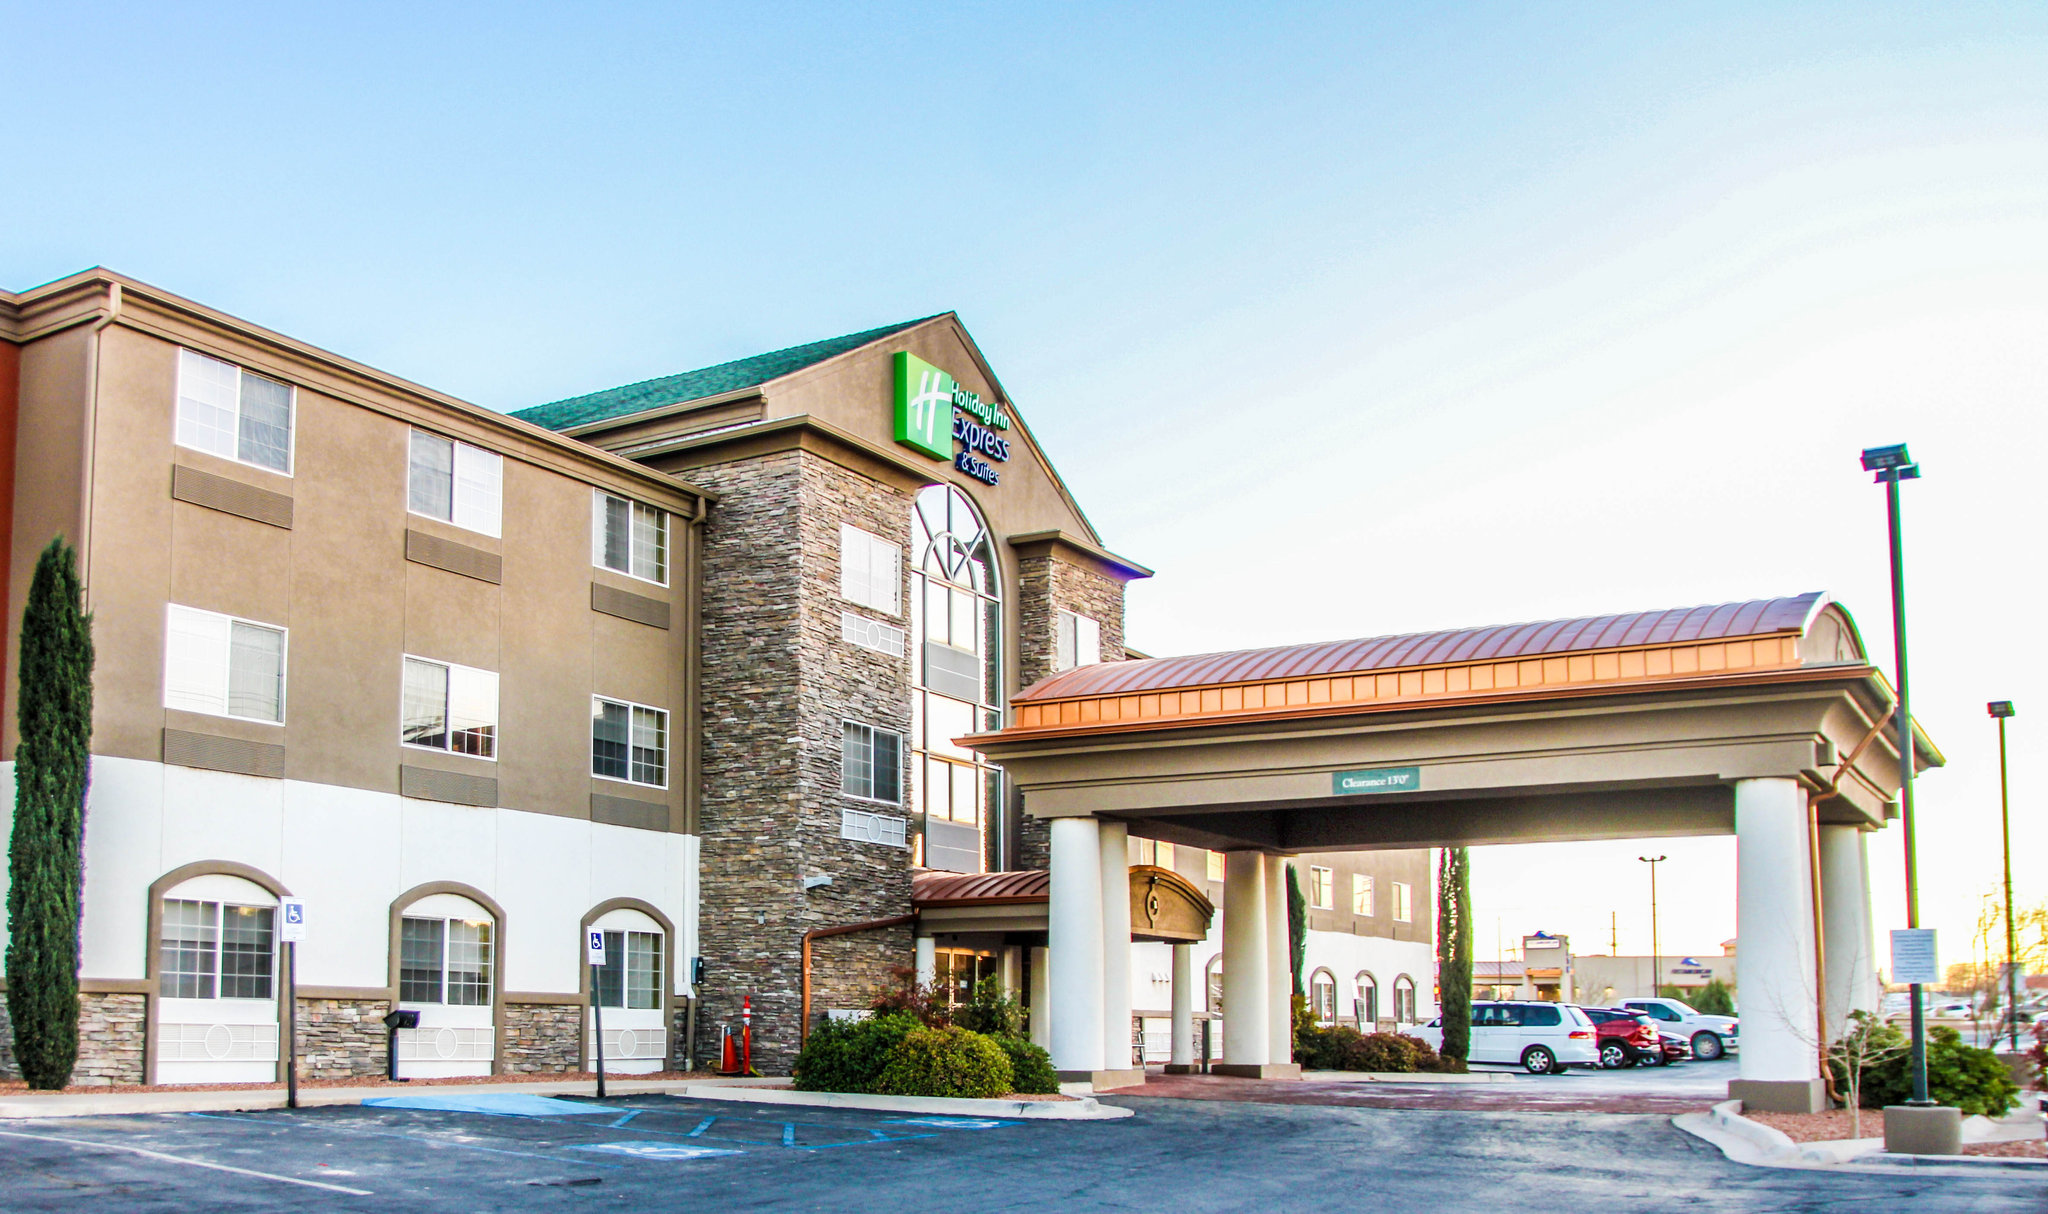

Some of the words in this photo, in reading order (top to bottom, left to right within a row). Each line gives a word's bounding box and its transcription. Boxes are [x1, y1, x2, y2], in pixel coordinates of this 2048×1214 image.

[951, 380, 993, 426] Holiday
[992, 403, 1010, 431] Inn
[951, 406, 1010, 462] Express
[961, 451, 970, 471] &
[970, 457, 999, 486] Suites
[1342, 777, 1386, 788] Clearance
